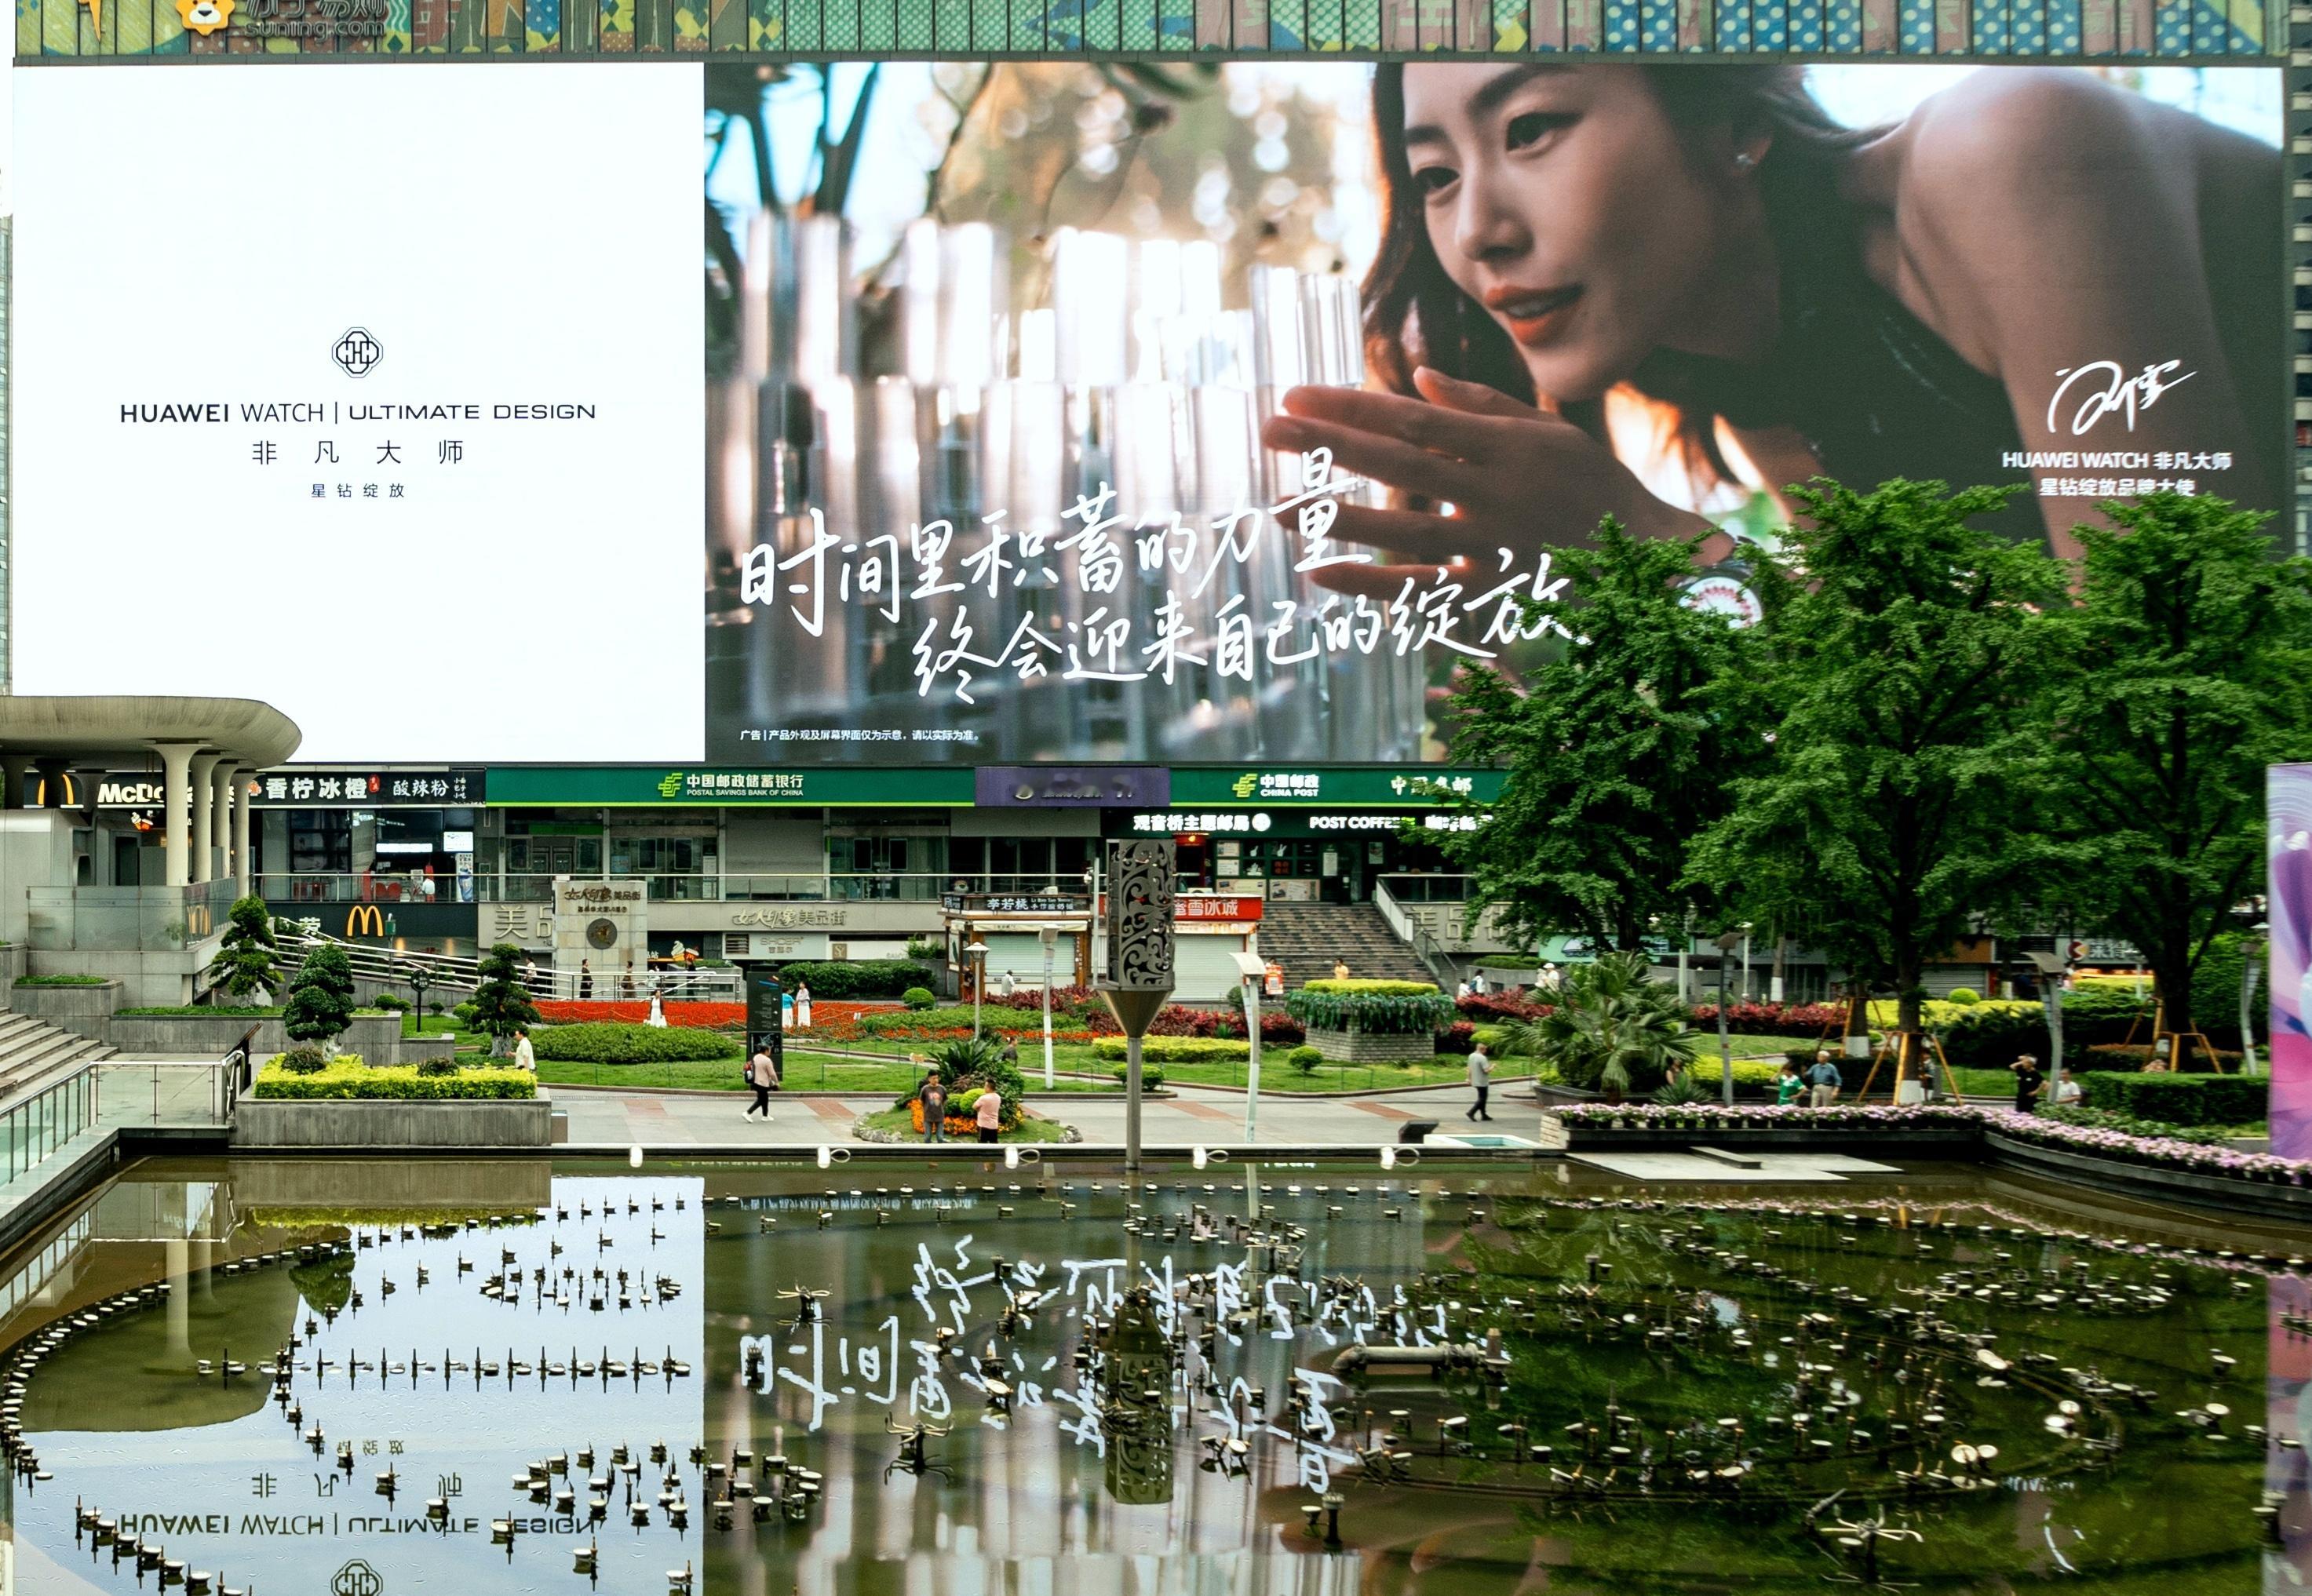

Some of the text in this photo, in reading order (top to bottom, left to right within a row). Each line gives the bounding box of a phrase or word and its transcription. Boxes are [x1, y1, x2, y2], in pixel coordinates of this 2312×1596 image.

[246, 21, 385, 39] suning.com
[121, 403, 596, 423] HUAWEI WATCH ULTIMATE DESIGN
[252, 440, 463, 465] 非凡大师
[2002, 451, 2232, 471] HUAWEI WATCH 非凡大师
[312, 483, 405, 498] 星钻绽放
[740, 446, 1373, 637] 时间里积蓄的力量
[266, 778, 367, 799] 香柠冰橙
[392, 779, 450, 797] 酸辣粉
[687, 774, 804, 788] 中国邮政储蓄银行
[1260, 774, 1319, 788] 中国邮政
[1260, 789, 1319, 797] CHINA POST
[1133, 814, 1250, 832] 观音桥主题邮局
[1310, 816, 1347, 829] POST
